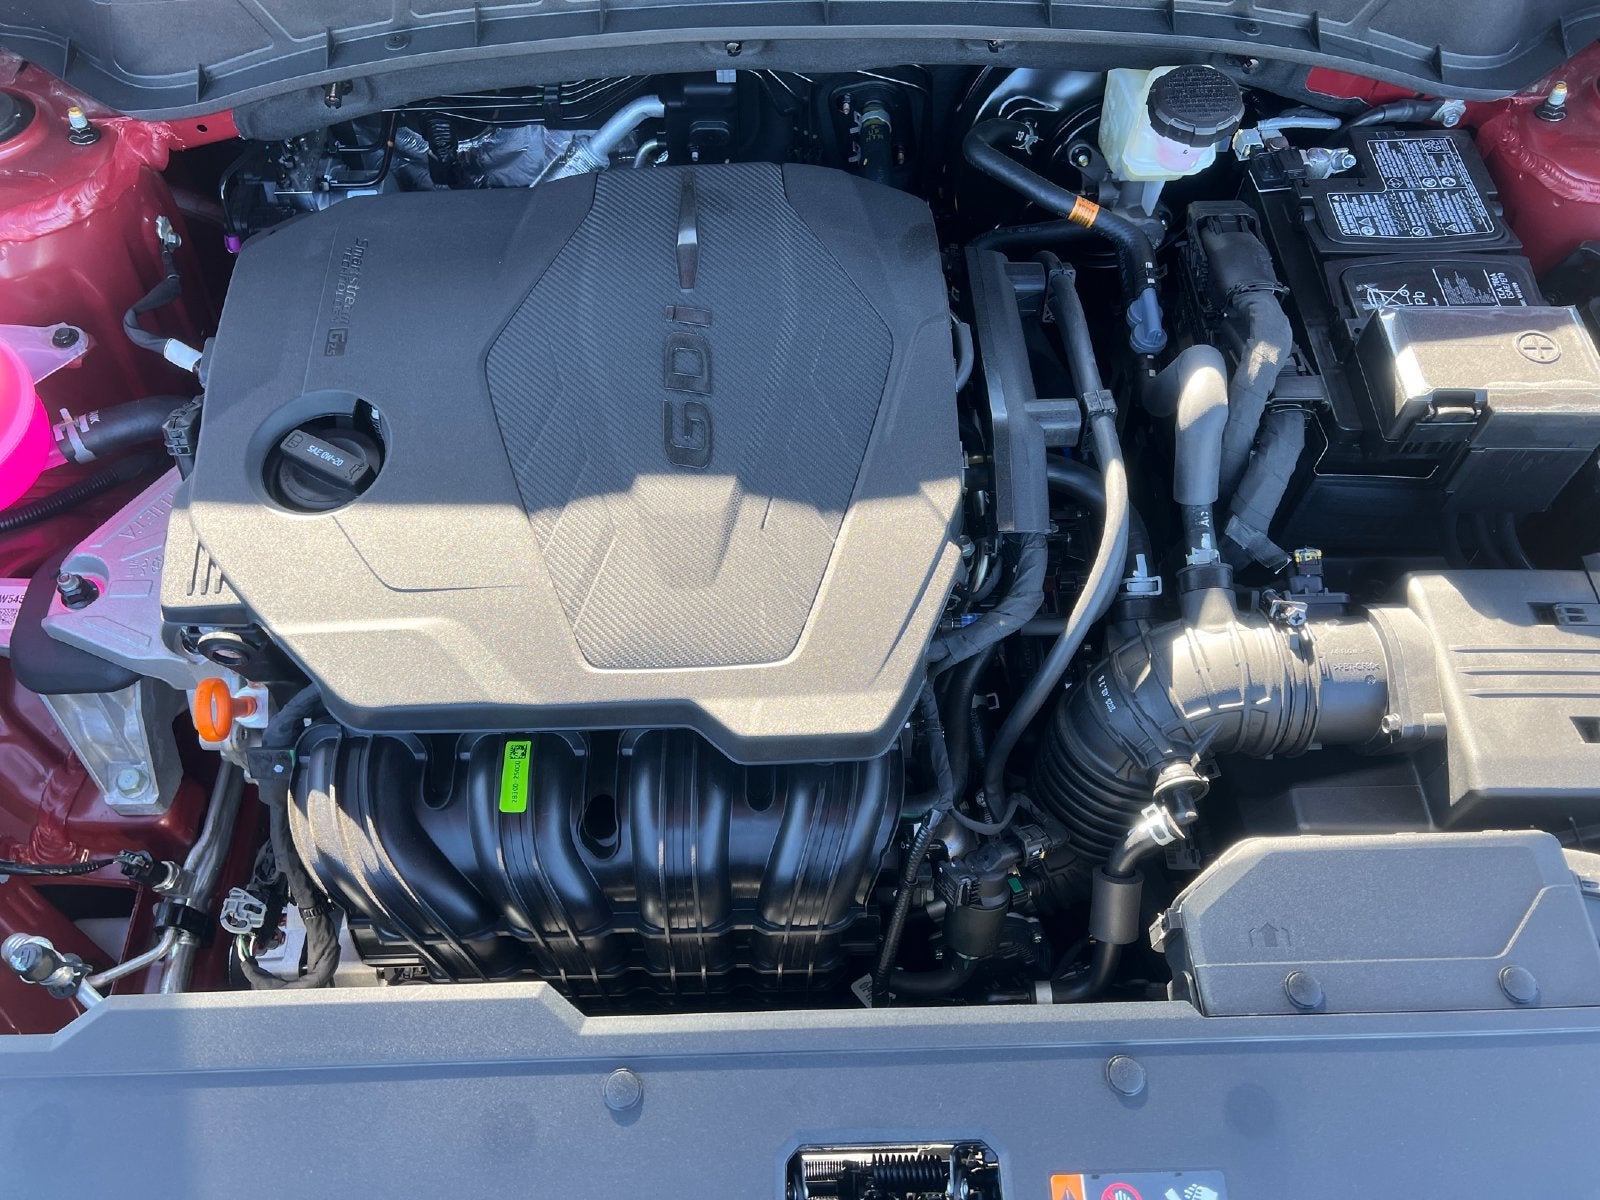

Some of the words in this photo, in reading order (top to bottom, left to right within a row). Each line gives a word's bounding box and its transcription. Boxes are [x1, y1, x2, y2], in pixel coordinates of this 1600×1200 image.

[1412, 291, 1428, 305] Pb
[662, 305, 713, 469] GDi
[306, 445, 323, 456] SAE
[321, 451, 344, 467] 0W-20
